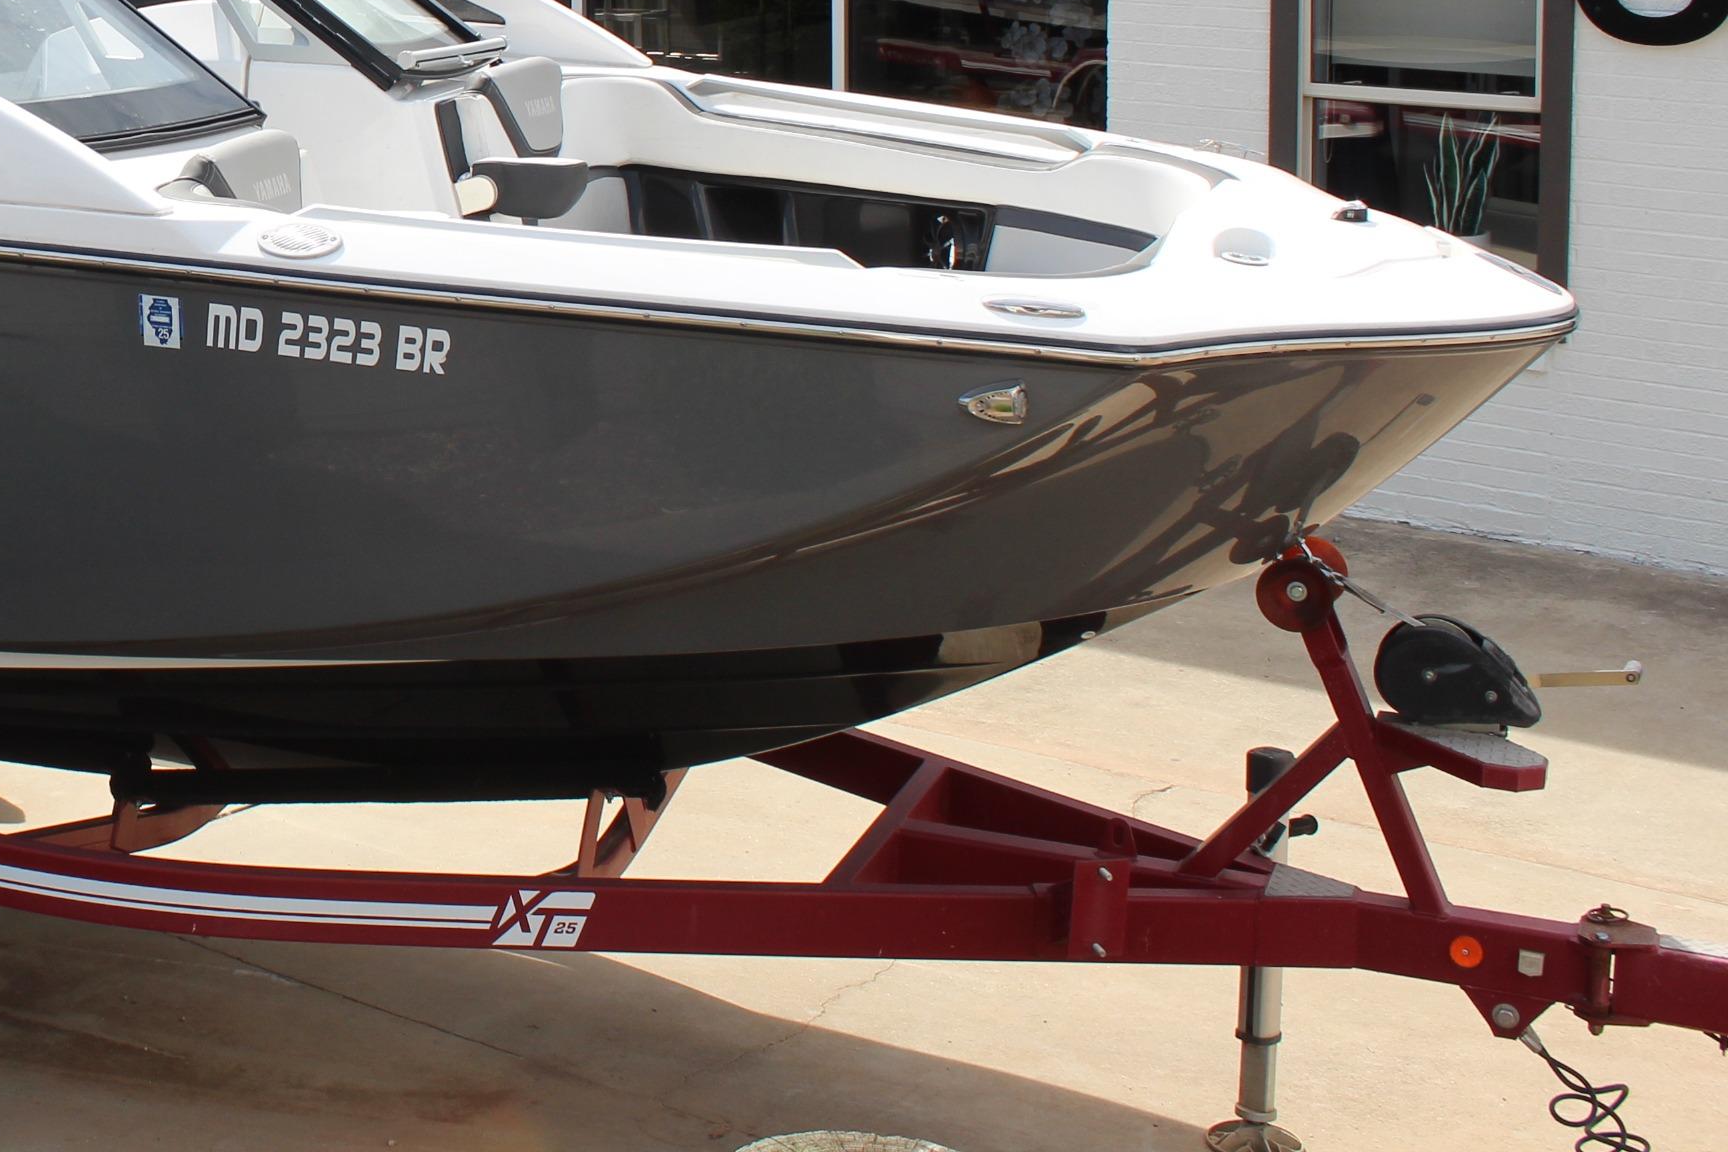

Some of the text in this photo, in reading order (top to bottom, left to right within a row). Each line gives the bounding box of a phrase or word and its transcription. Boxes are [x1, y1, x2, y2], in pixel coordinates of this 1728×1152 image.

[252, 171, 293, 202] YAMAHA
[157, 327, 170, 340] 25
[206, 302, 264, 353] MD
[277, 311, 383, 367] 2323
[395, 325, 452, 375] BR
[553, 921, 578, 935] 25
